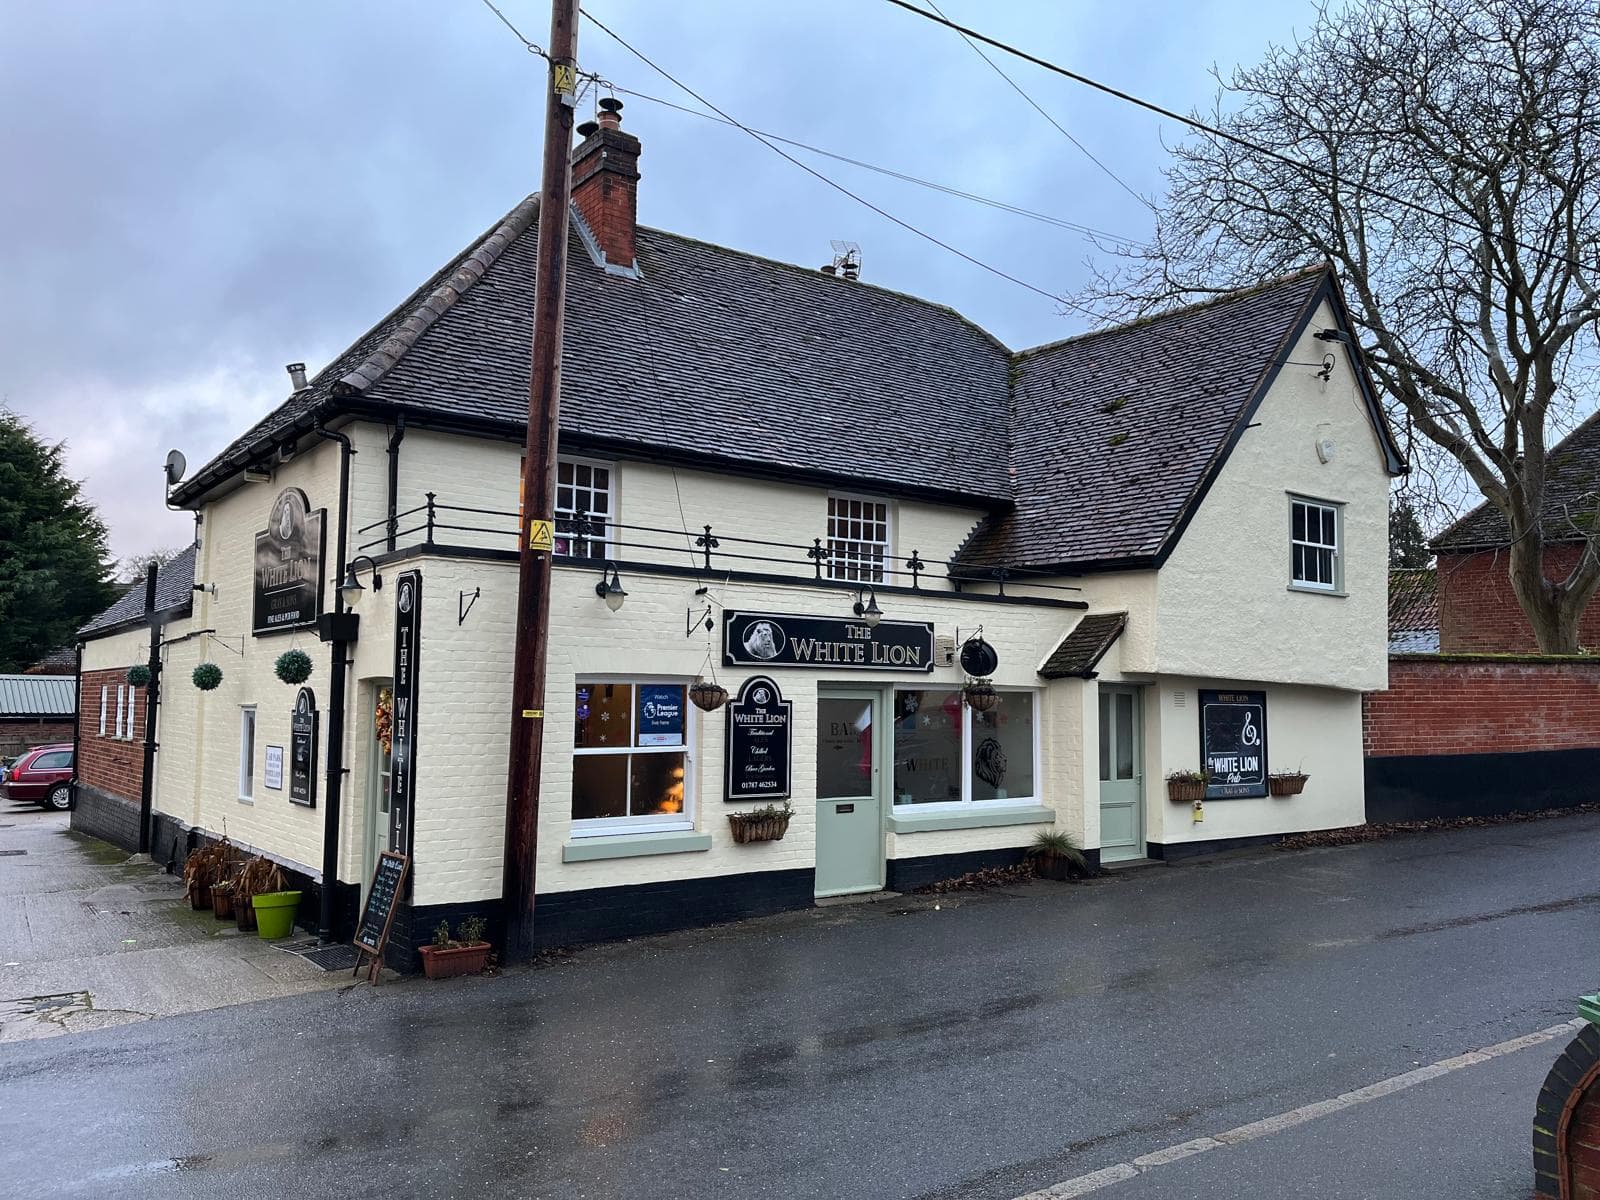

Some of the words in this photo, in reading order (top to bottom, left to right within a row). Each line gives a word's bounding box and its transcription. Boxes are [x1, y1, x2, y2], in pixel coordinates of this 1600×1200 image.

[262, 564, 289, 589] WHITE
[289, 557, 311, 582] LION
[844, 624, 872, 640] THE
[400, 626, 408, 685] THE
[790, 637, 865, 662] WHITE
[871, 641, 921, 665] LION
[656, 703, 678, 711] Premier
[656, 710, 679, 718] League
[734, 713, 763, 723] WHITE
[766, 713, 787, 723] LION
[397, 697, 408, 793] WHITE
[1214, 757, 1238, 773] WHITE
[1240, 756, 1259, 772] LION
[741, 781, 758, 789] 01787
[1226, 772, 1241, 783] Pub
